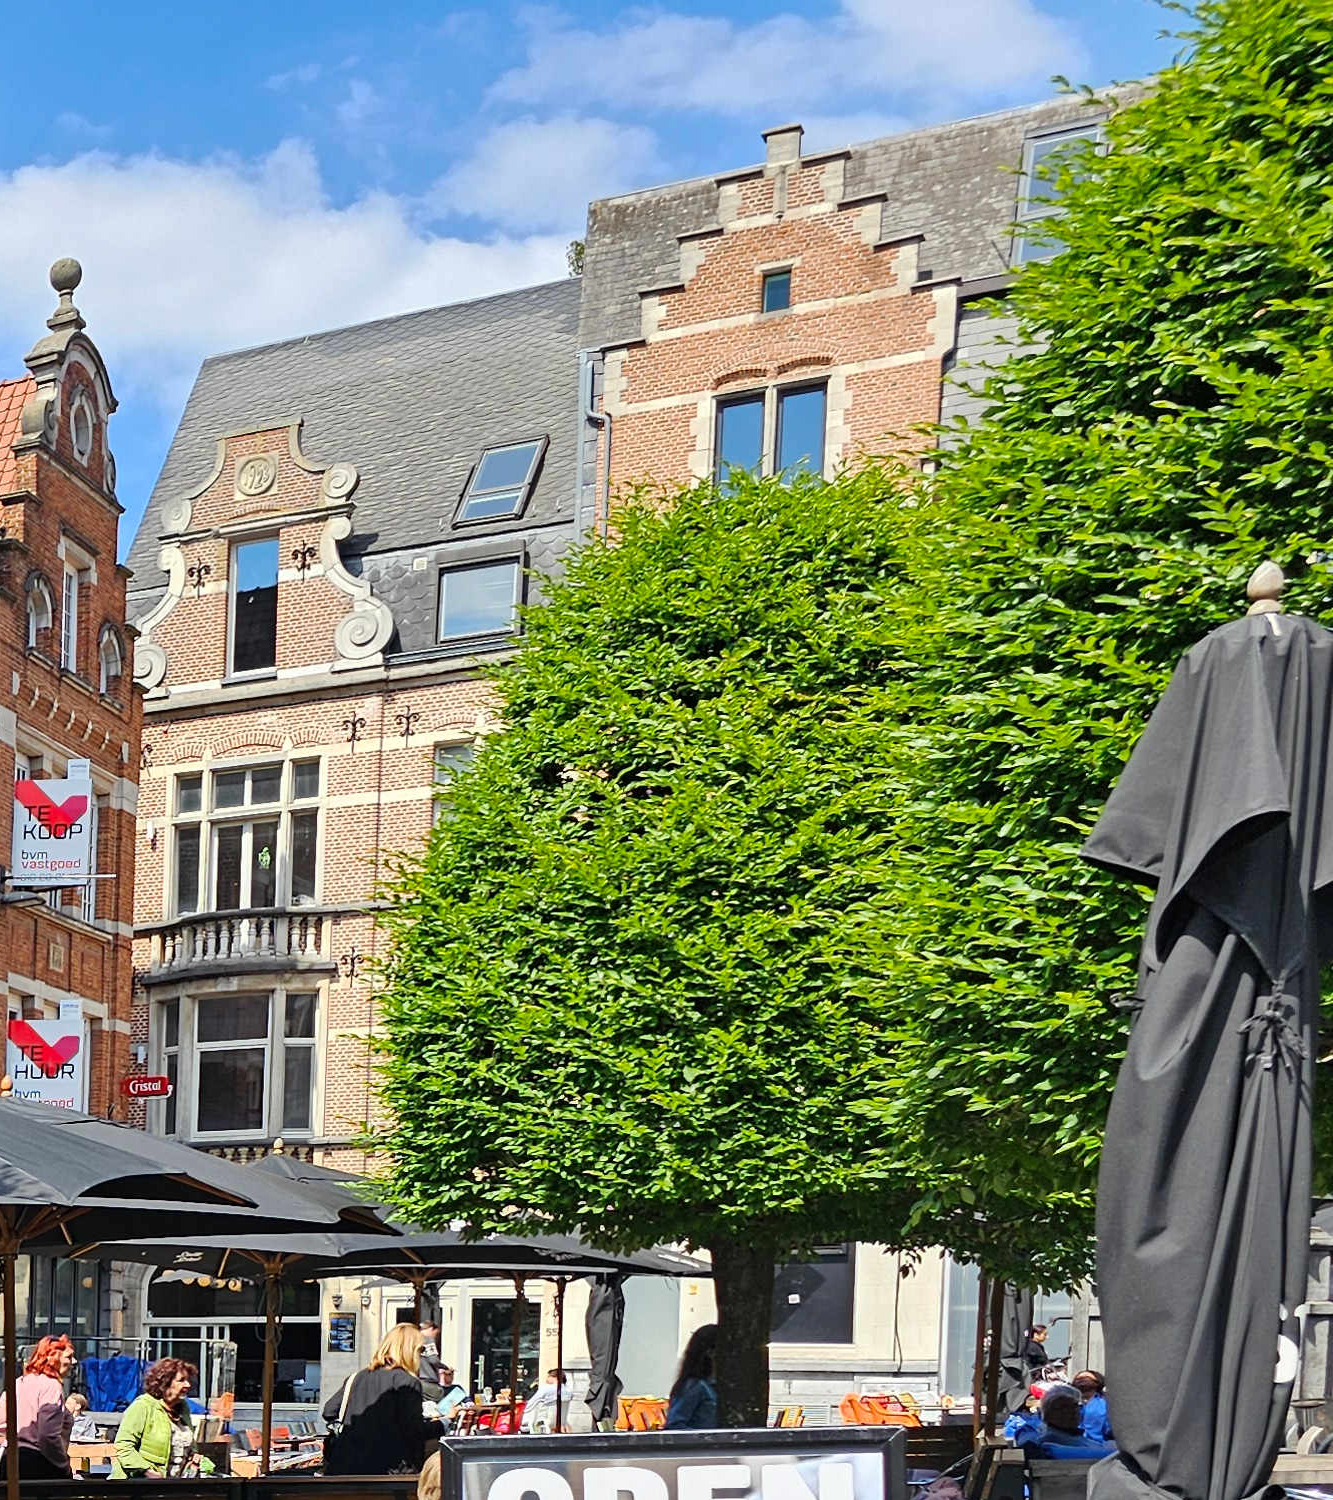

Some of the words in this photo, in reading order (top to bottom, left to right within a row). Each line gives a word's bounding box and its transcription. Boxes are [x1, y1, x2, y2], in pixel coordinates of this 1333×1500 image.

[24, 804, 52, 822] TE
[22, 823, 83, 840] KOOP
[21, 850, 48, 860] bvm
[21, 858, 81, 871] vastgoed
[19, 1045, 45, 1062] TE
[14, 1064, 75, 1080] HUUR
[129, 1080, 162, 1095] Cristal
